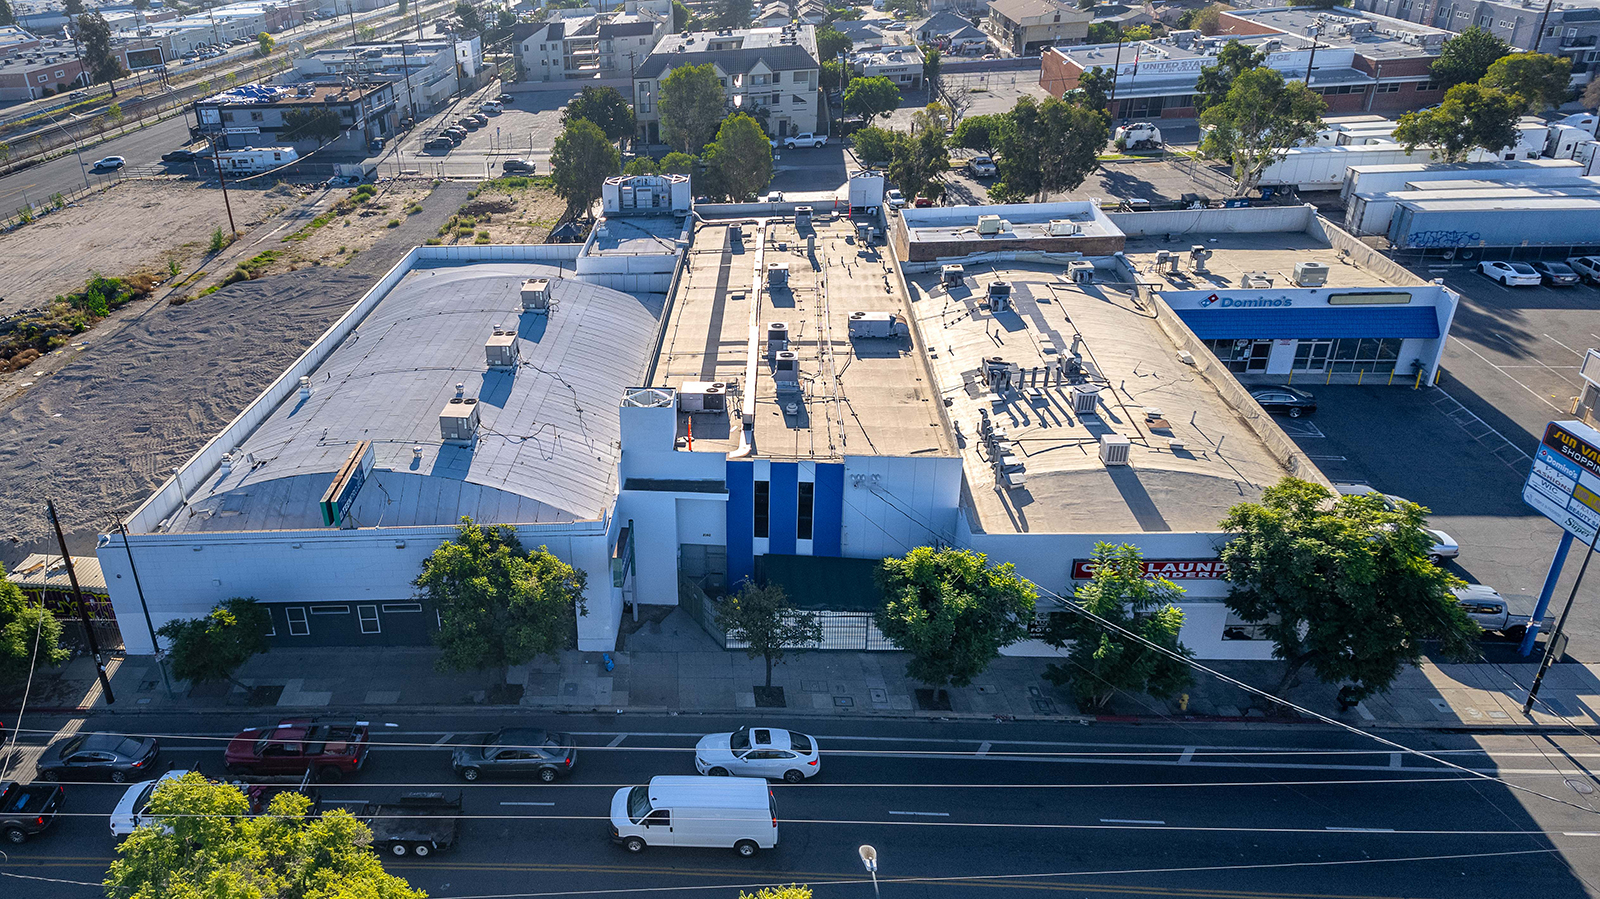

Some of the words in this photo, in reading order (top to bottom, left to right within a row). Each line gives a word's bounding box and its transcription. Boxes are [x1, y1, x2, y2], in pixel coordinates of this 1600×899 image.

[1142, 61, 1179, 70] UNITED
[1221, 296, 1293, 308] Domino's
[1546, 455, 1578, 479] Domino's
[1541, 480, 1558, 494] WIC
[1569, 505, 1591, 523] BEAUTY
[1565, 517, 1590, 538] Super
